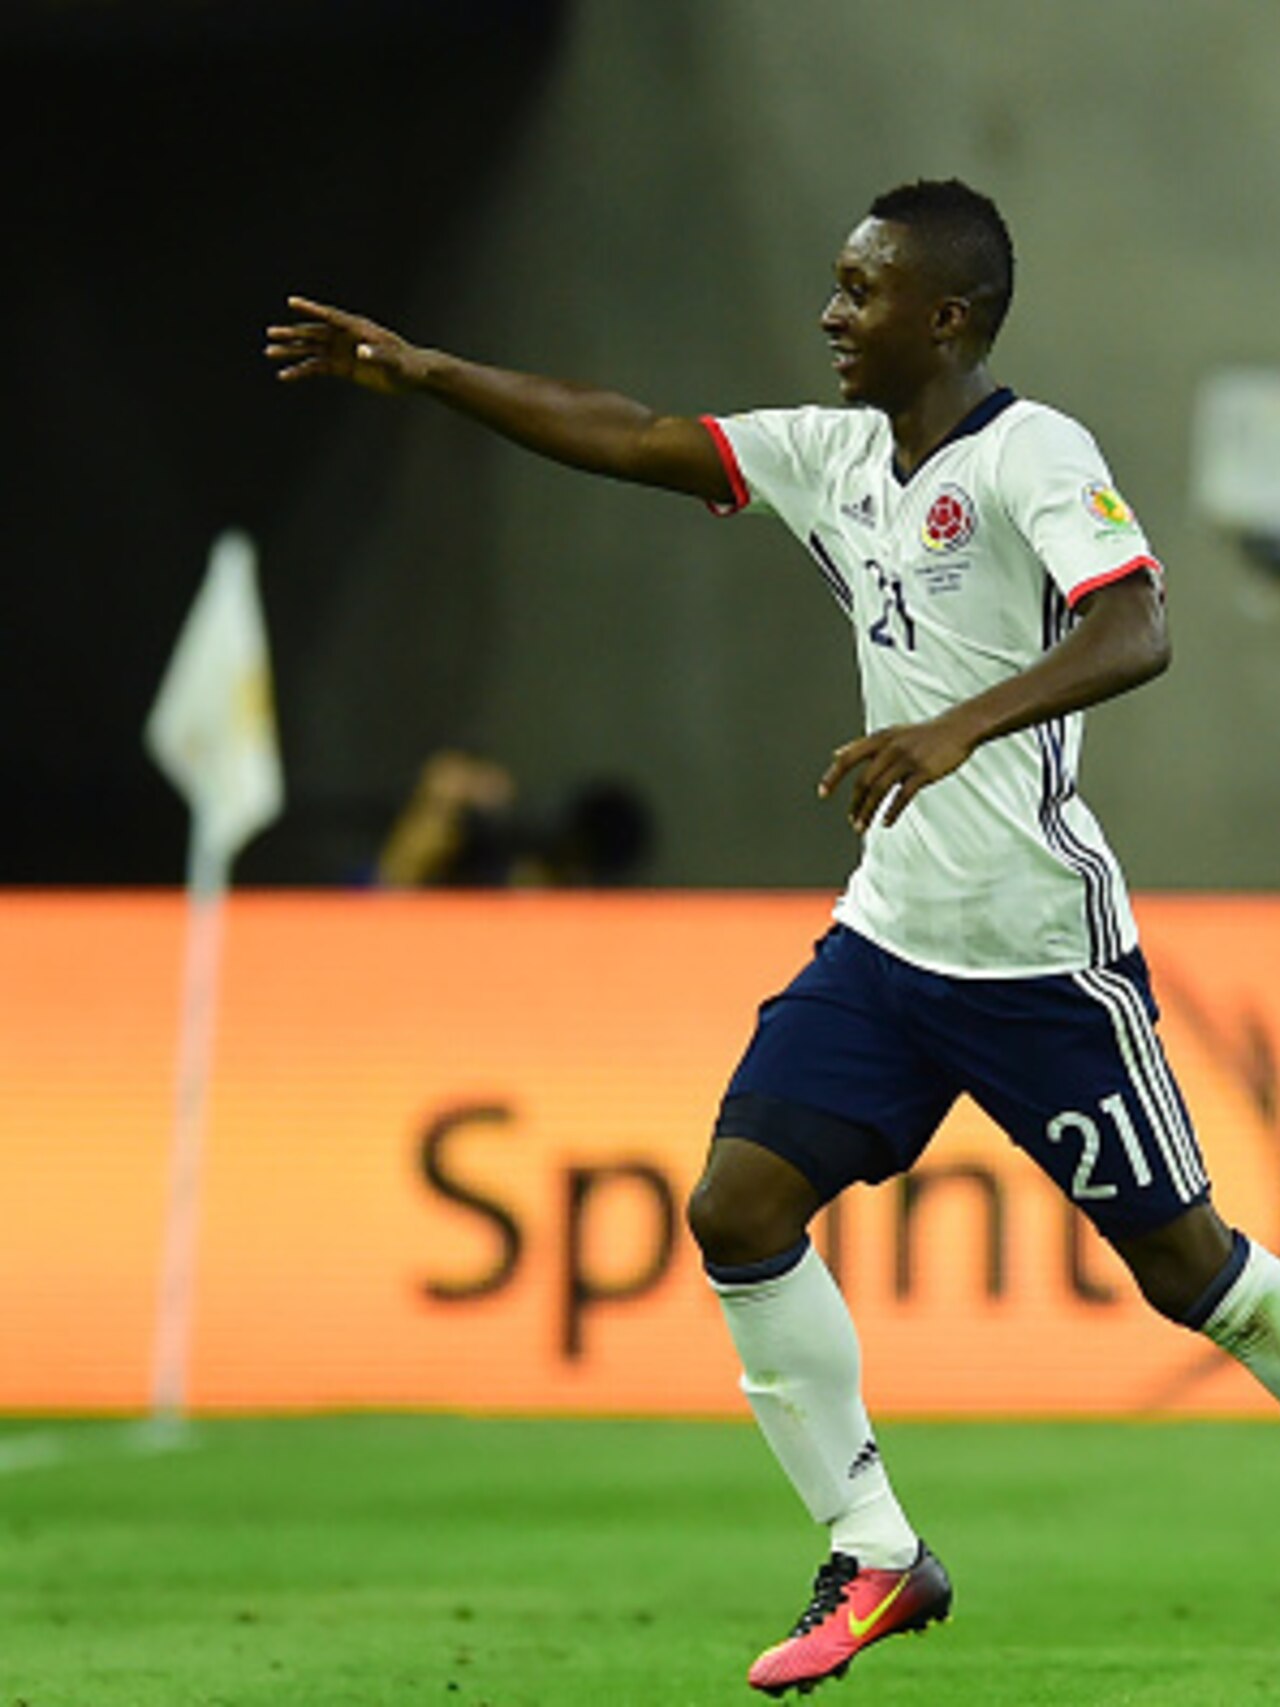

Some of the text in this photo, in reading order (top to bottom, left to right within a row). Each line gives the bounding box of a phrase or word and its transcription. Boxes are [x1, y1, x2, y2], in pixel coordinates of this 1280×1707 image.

[865, 560, 915, 651] 21
[1047, 1093, 1152, 1199] 21
[421, 1105, 1119, 1361] Spnt
